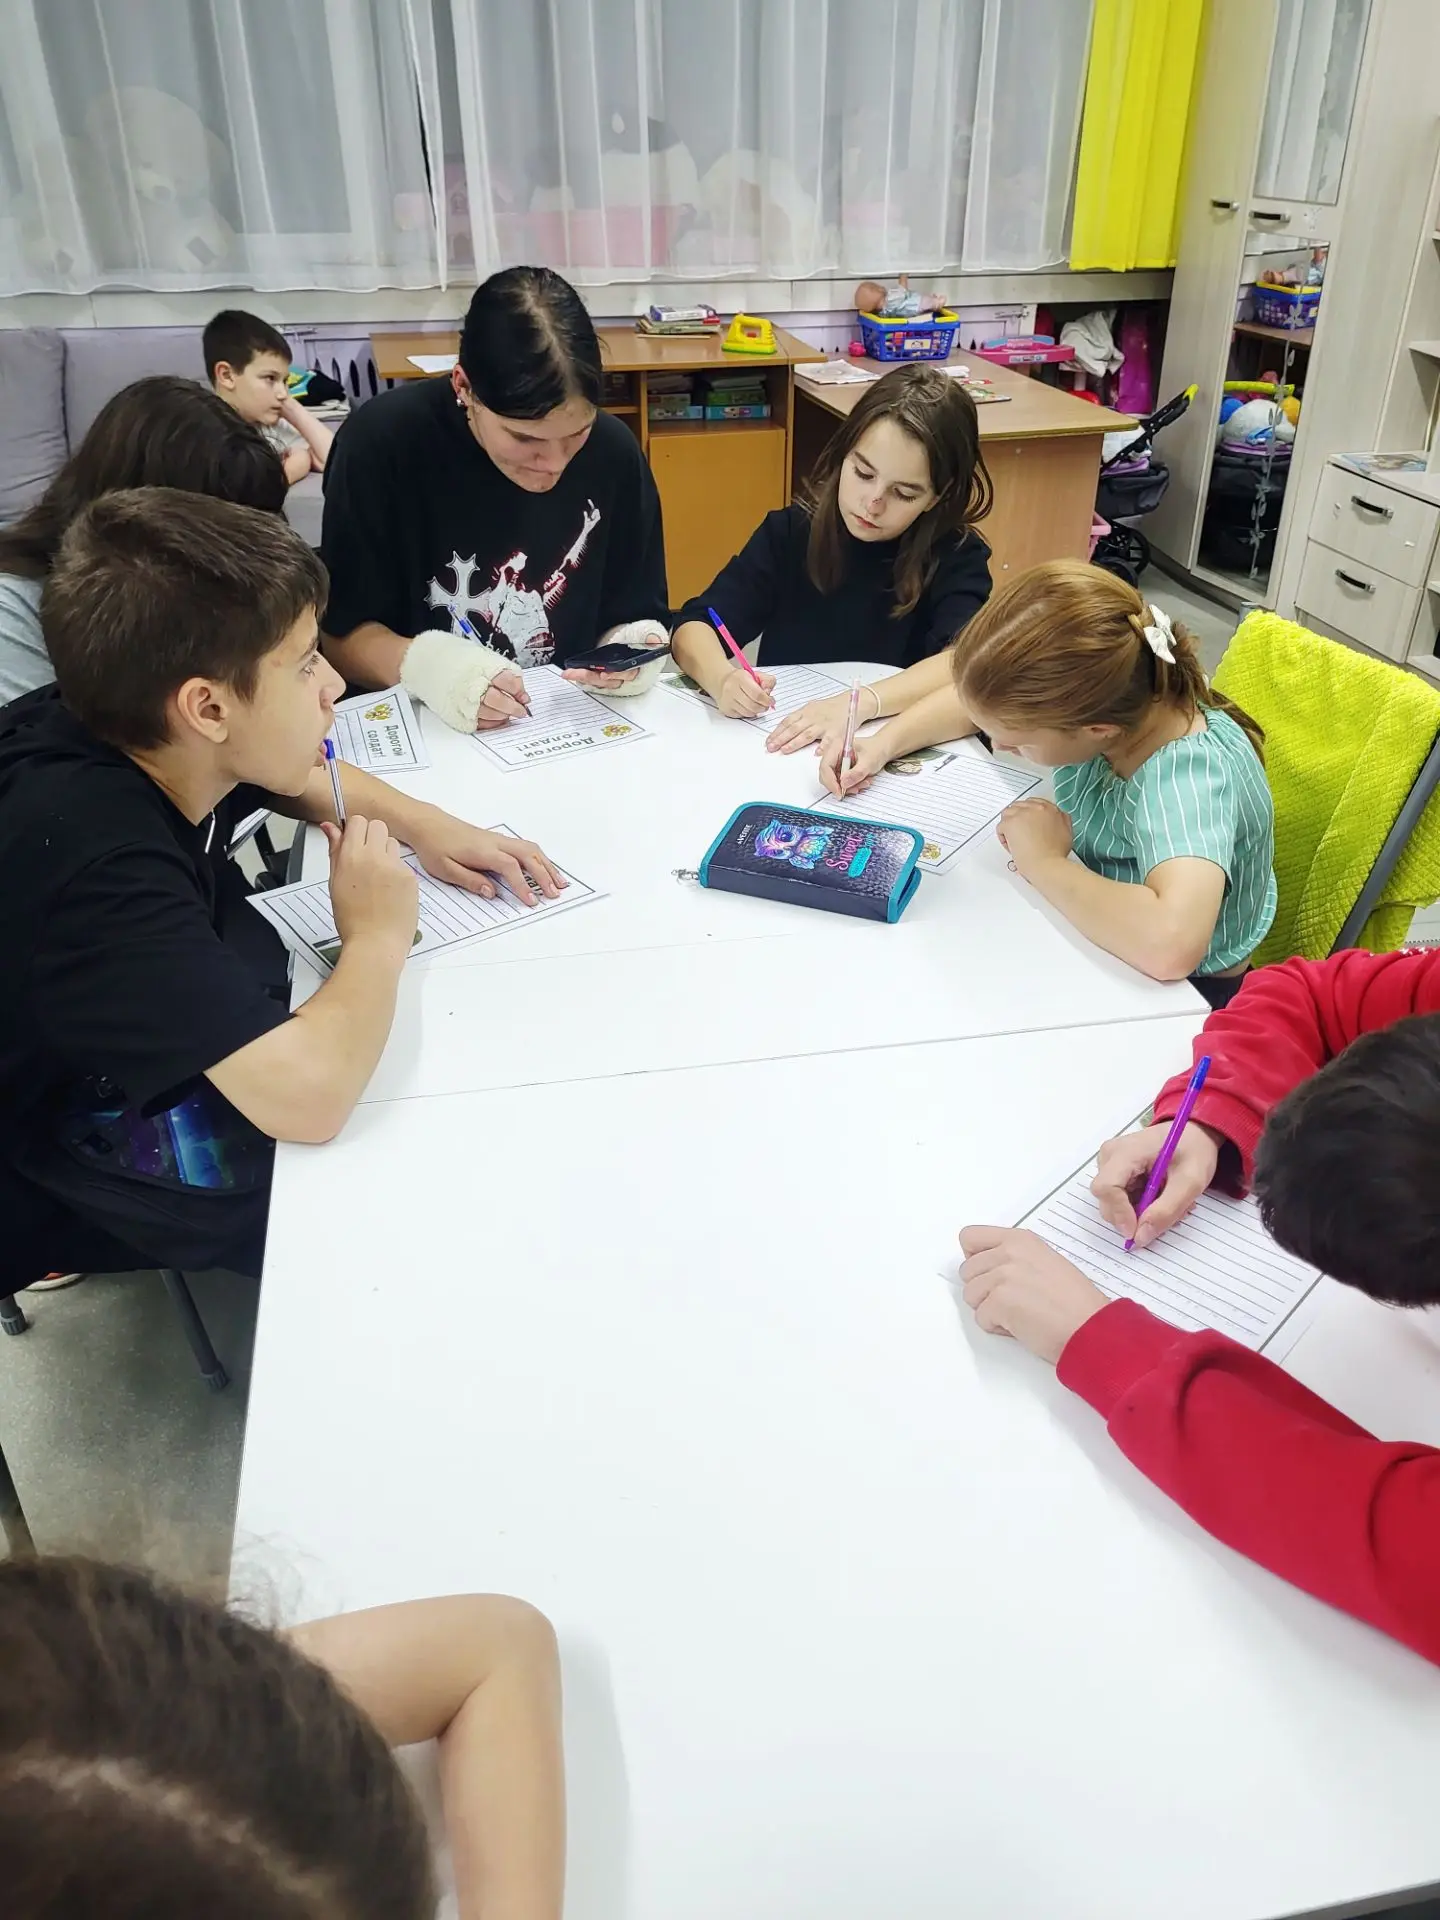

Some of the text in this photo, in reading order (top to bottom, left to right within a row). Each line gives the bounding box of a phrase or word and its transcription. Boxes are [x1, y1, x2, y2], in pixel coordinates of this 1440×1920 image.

[367, 729, 387, 758] солдат!
[384, 724, 406, 757] Дорогой
[516, 731, 581, 752] солдат!
[523, 736, 595, 759] Дорогой
